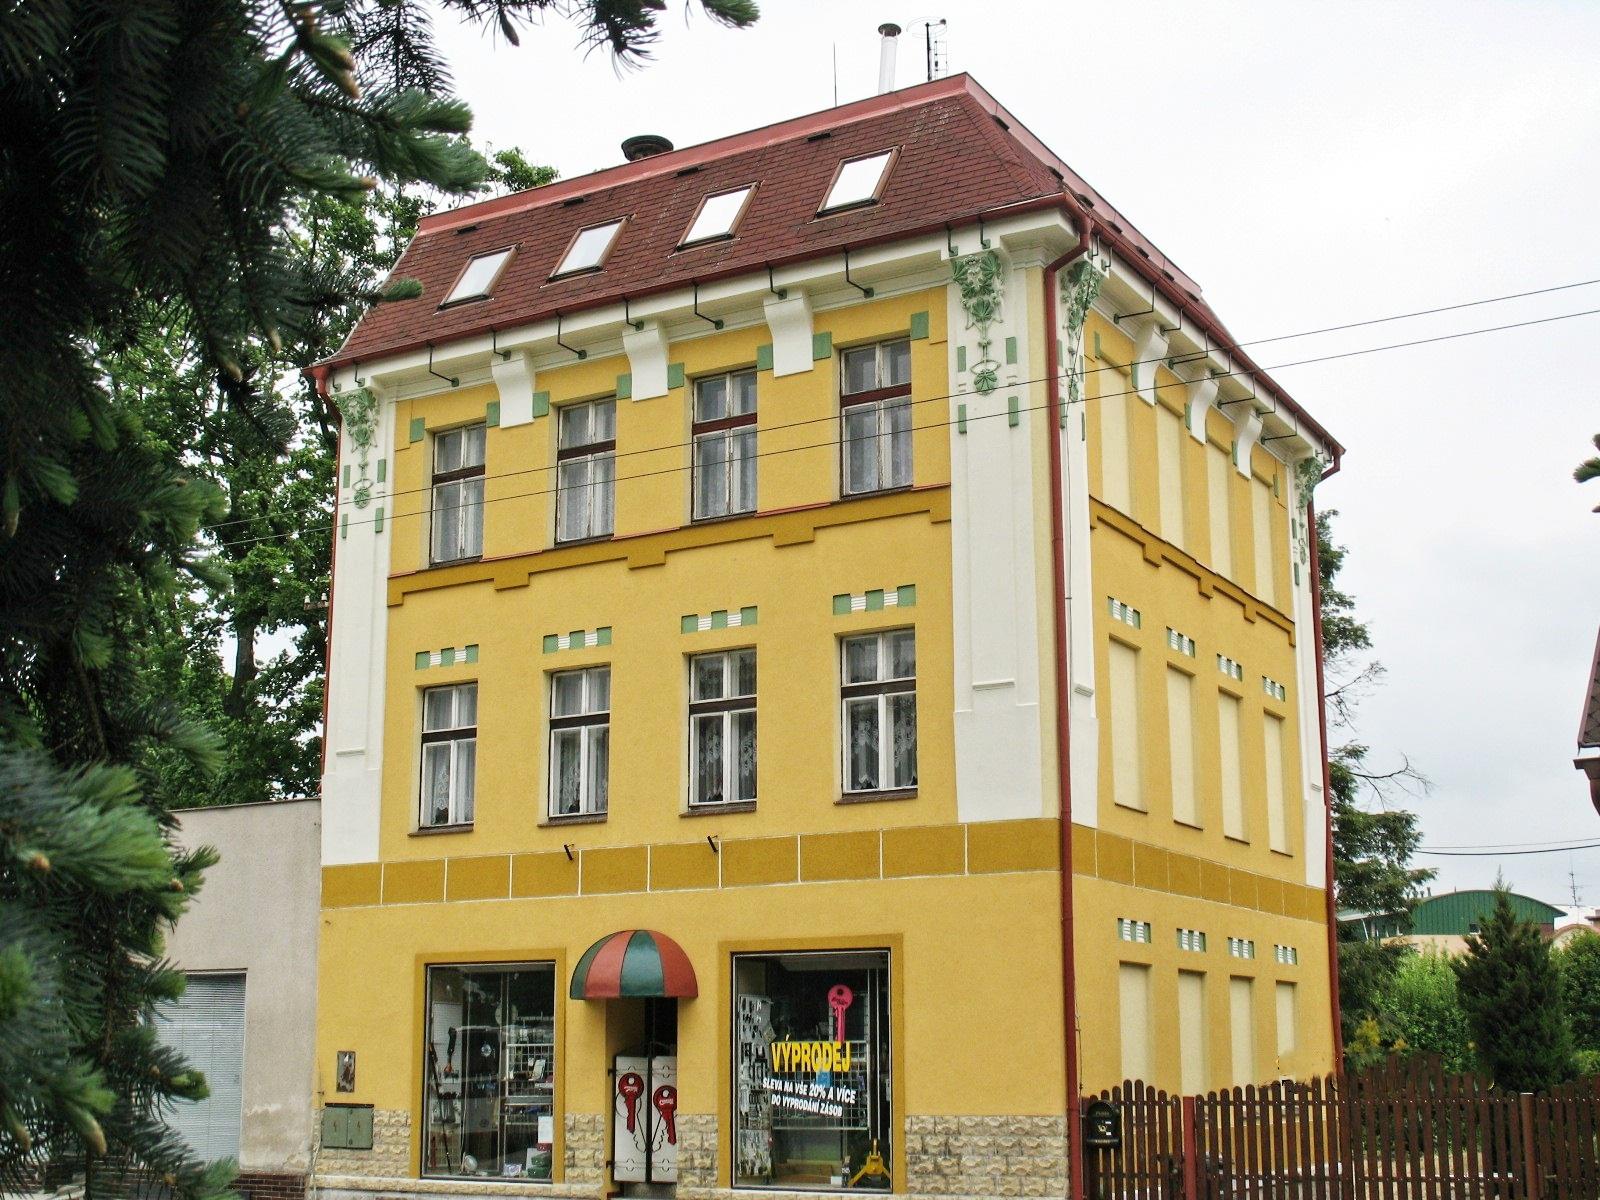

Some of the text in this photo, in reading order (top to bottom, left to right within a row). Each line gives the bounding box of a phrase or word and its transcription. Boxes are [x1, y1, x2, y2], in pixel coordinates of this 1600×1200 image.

[771, 1034, 851, 1073] VÝPRODEJ
[762, 1077, 856, 1104] SLEVA NA VŠE 20% A VÍCE
[771, 1094, 843, 1117] DO VYPRODÁNÍ ZÁSOB
